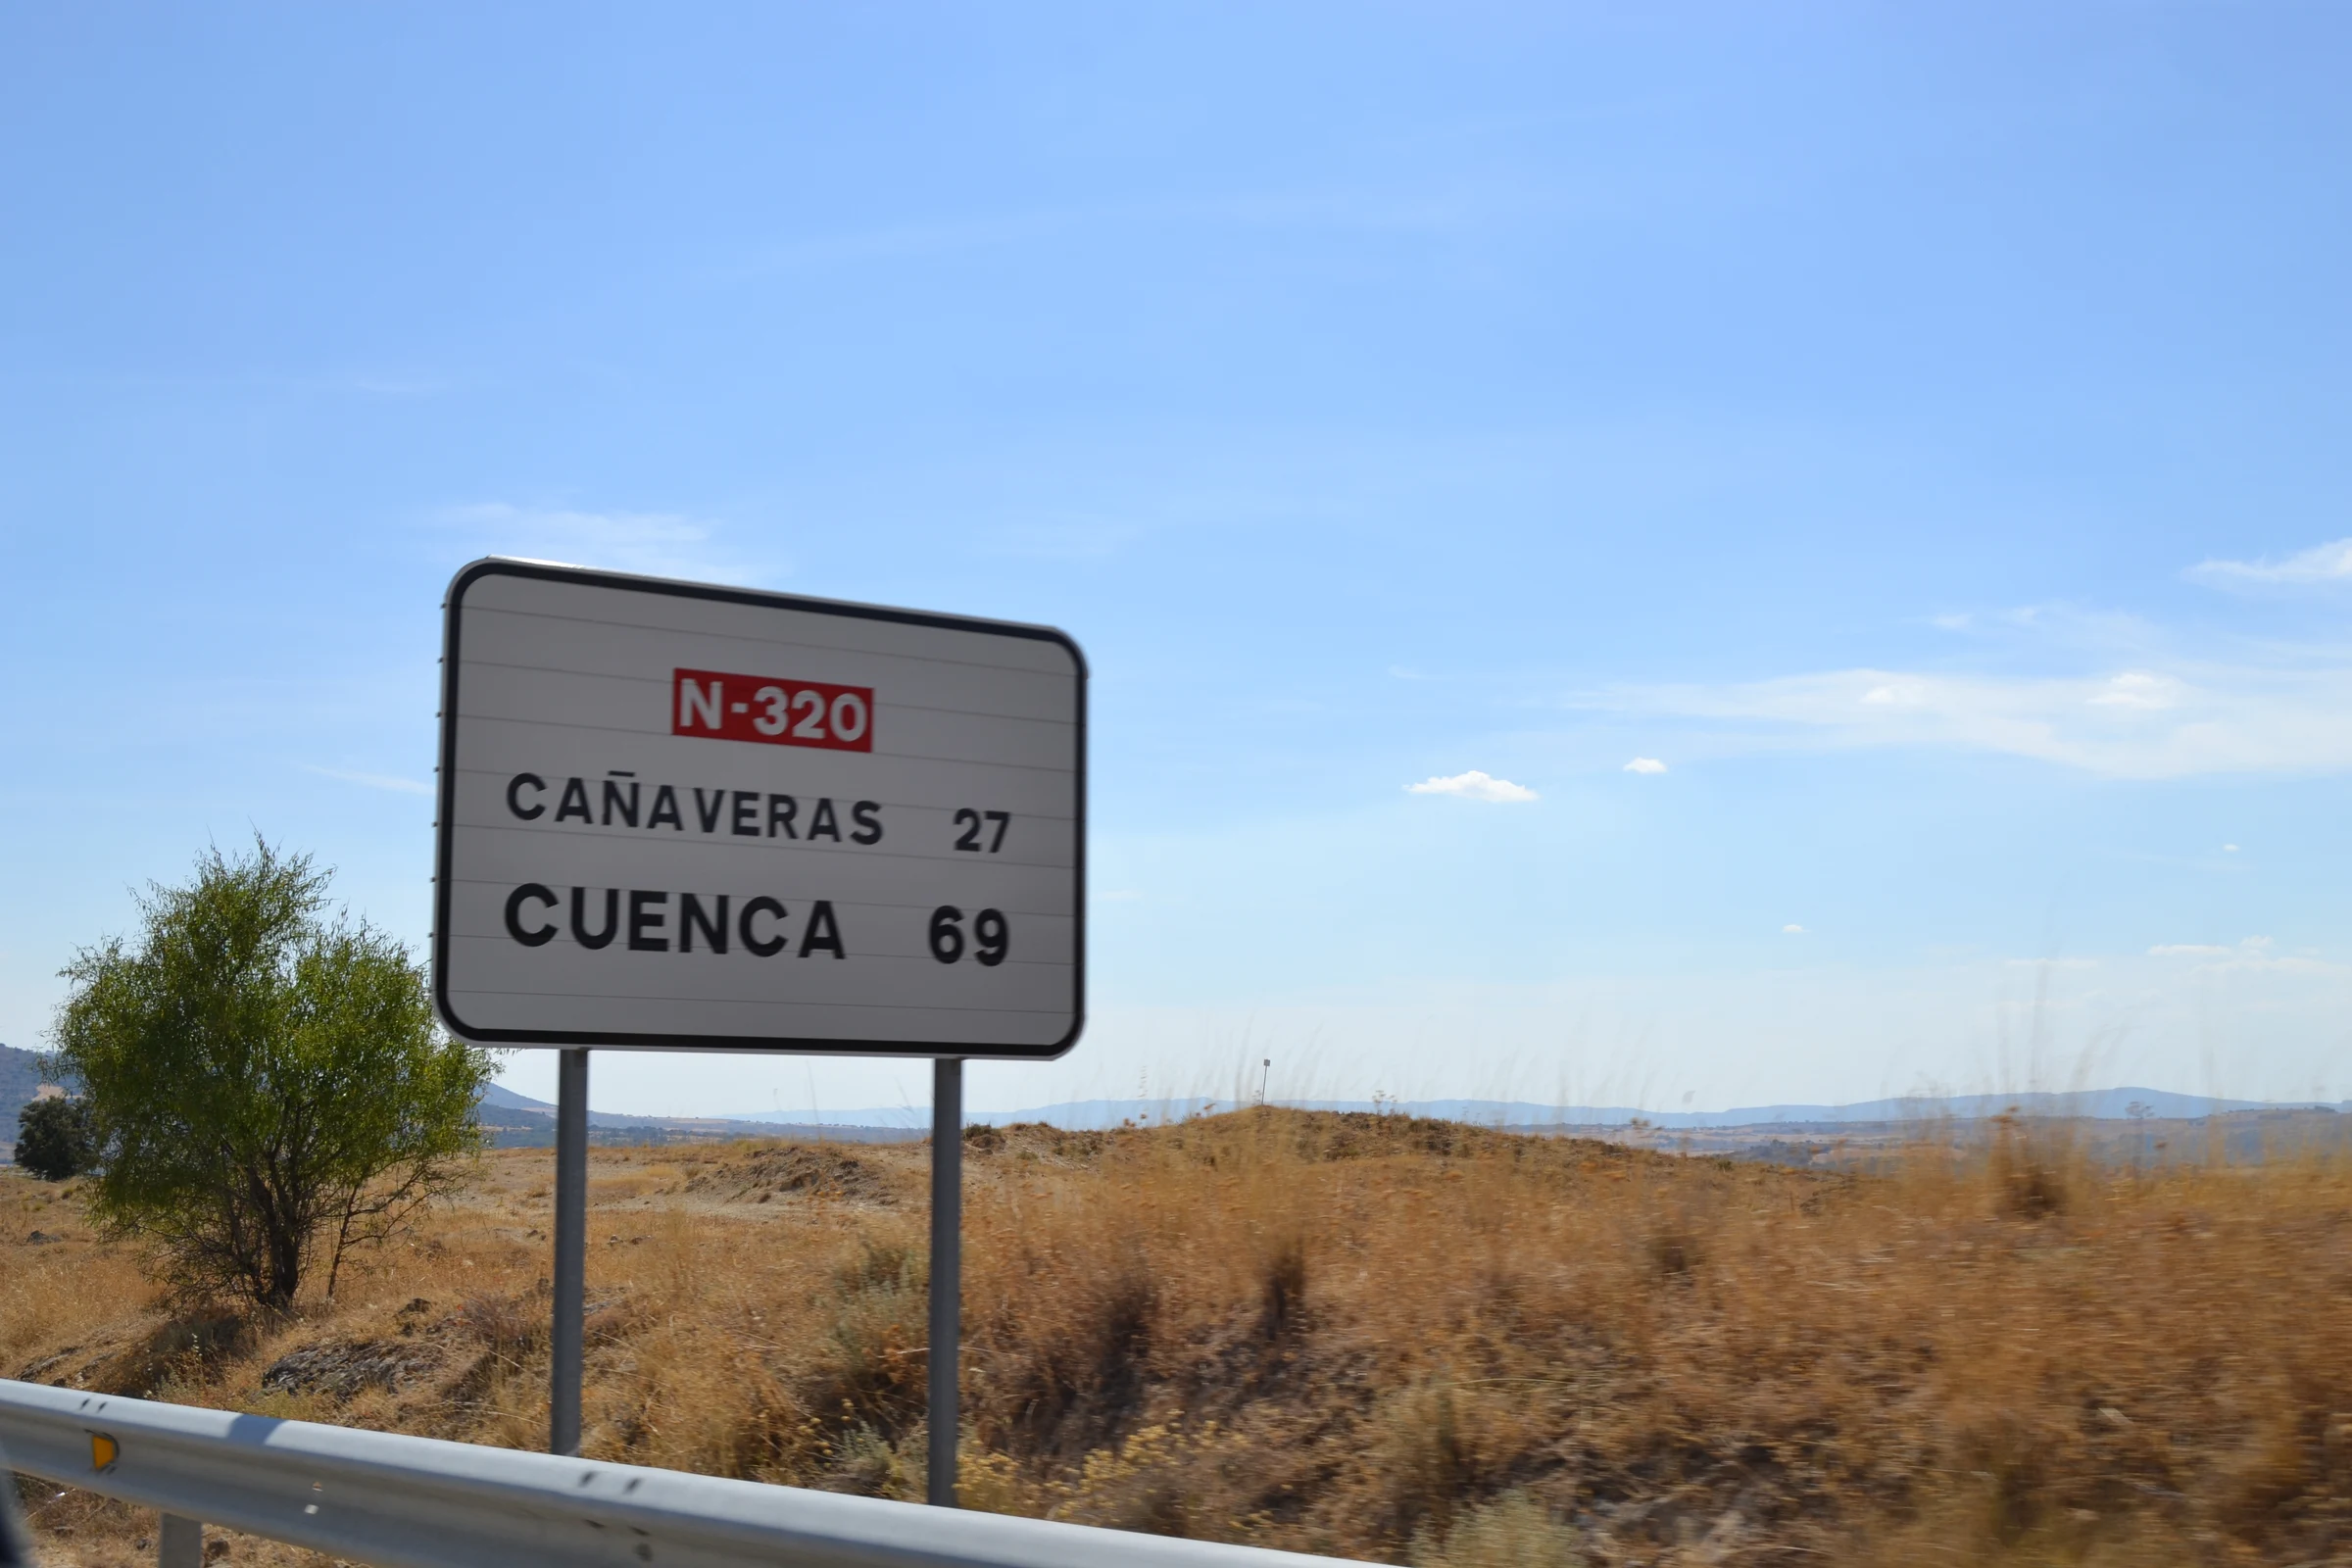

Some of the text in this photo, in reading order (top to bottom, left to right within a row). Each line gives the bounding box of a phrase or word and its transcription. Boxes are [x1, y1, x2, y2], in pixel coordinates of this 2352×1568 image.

[679, 677, 867, 742] N-320
[506, 769, 1011, 854] CAÑAVERAS 27
[504, 882, 1010, 967] CUENCA 69
